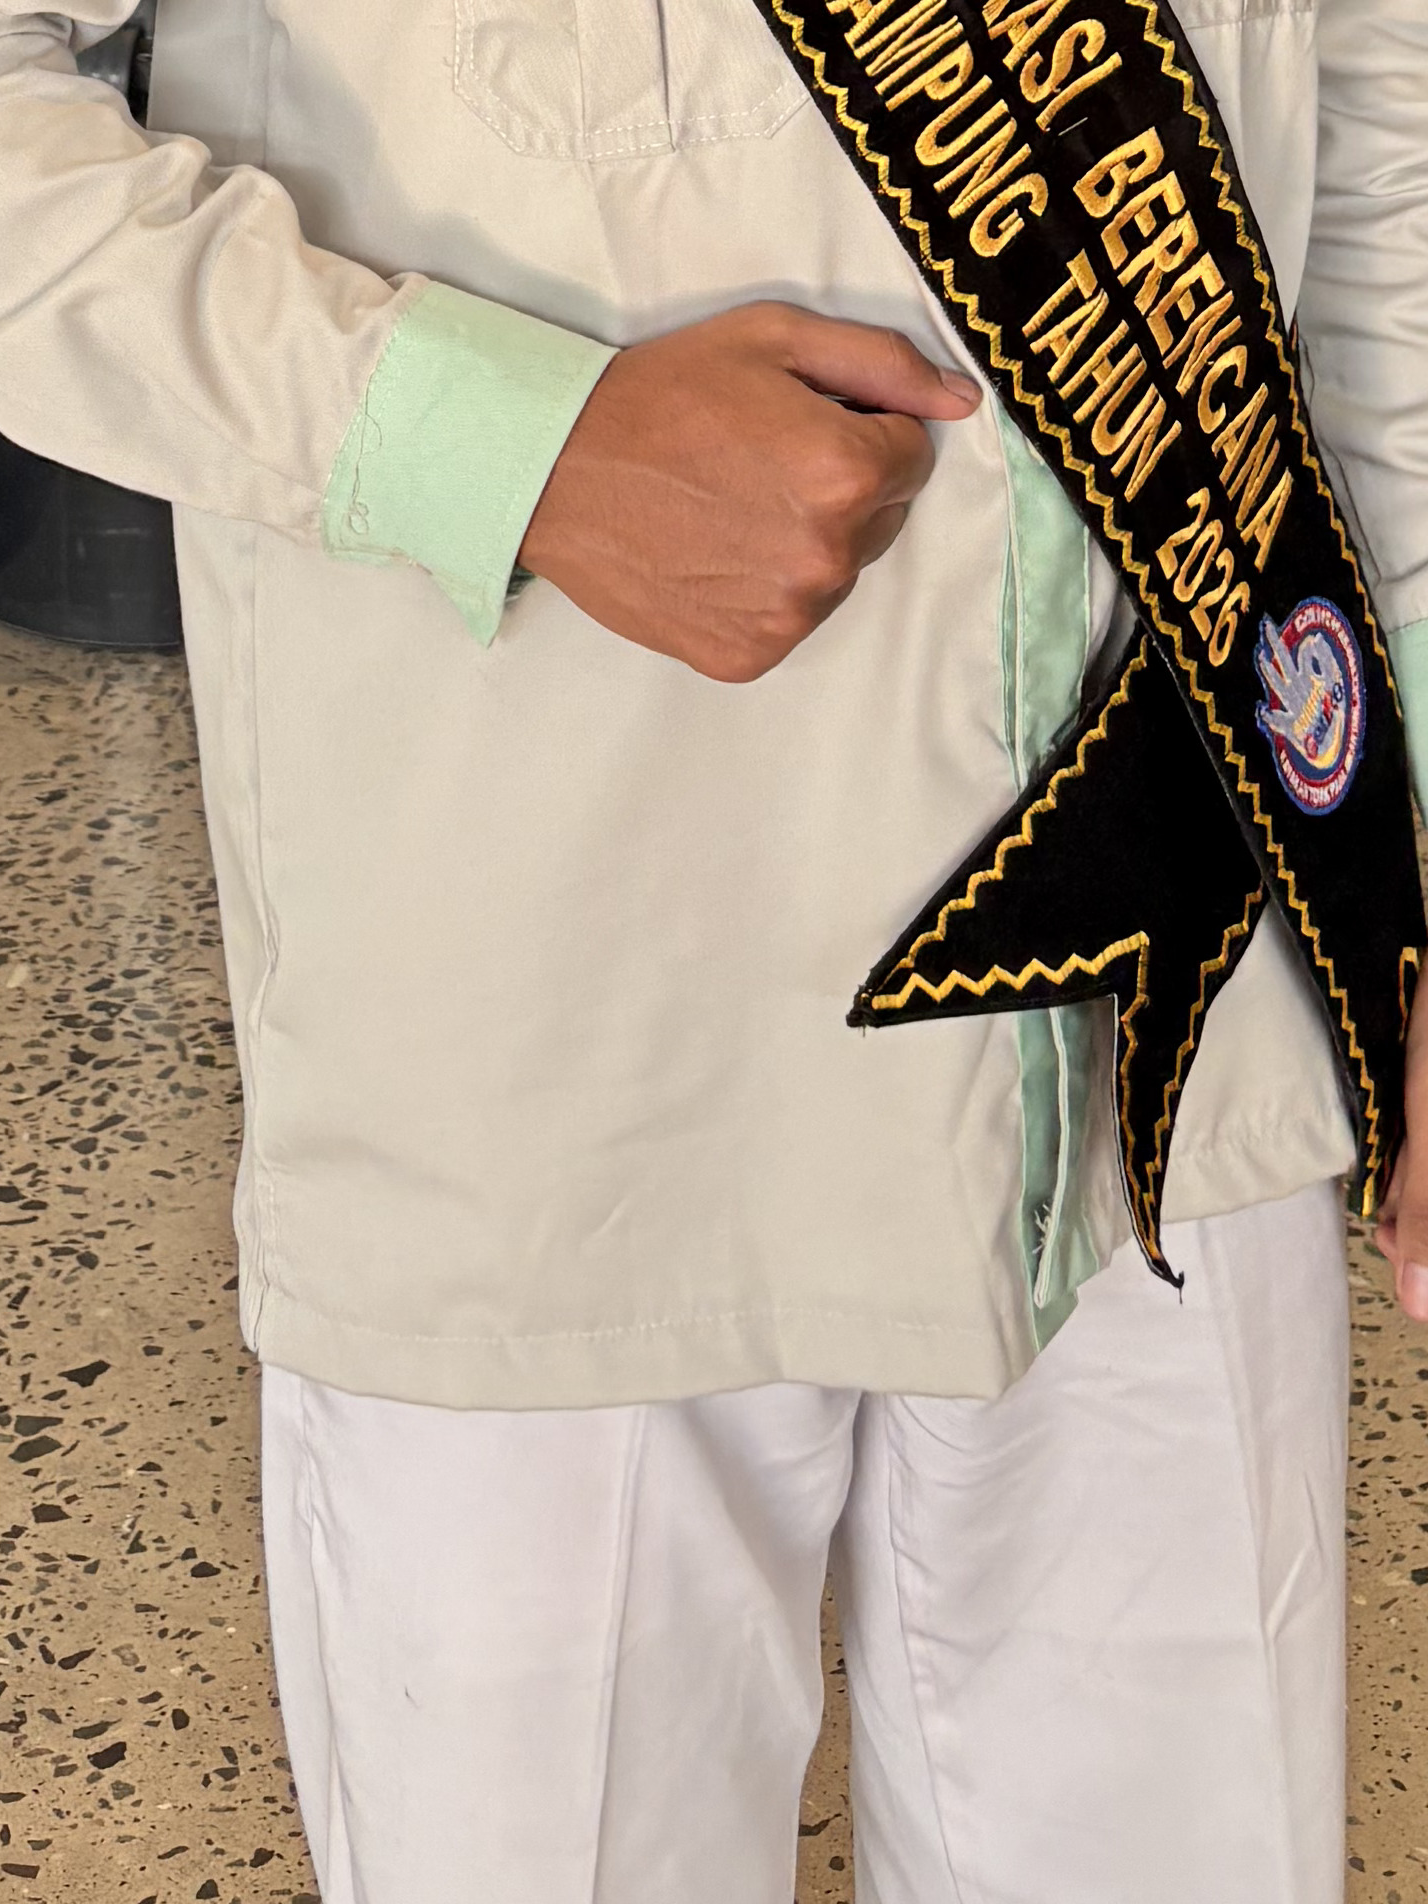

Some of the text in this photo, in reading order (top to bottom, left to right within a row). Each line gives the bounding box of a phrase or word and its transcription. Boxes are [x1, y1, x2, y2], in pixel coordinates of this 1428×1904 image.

[1022, 250, 1181, 503] TAHUN
[1156, 487, 1251, 668] 2026
[1073, 128, 1293, 573] BERENCANA
